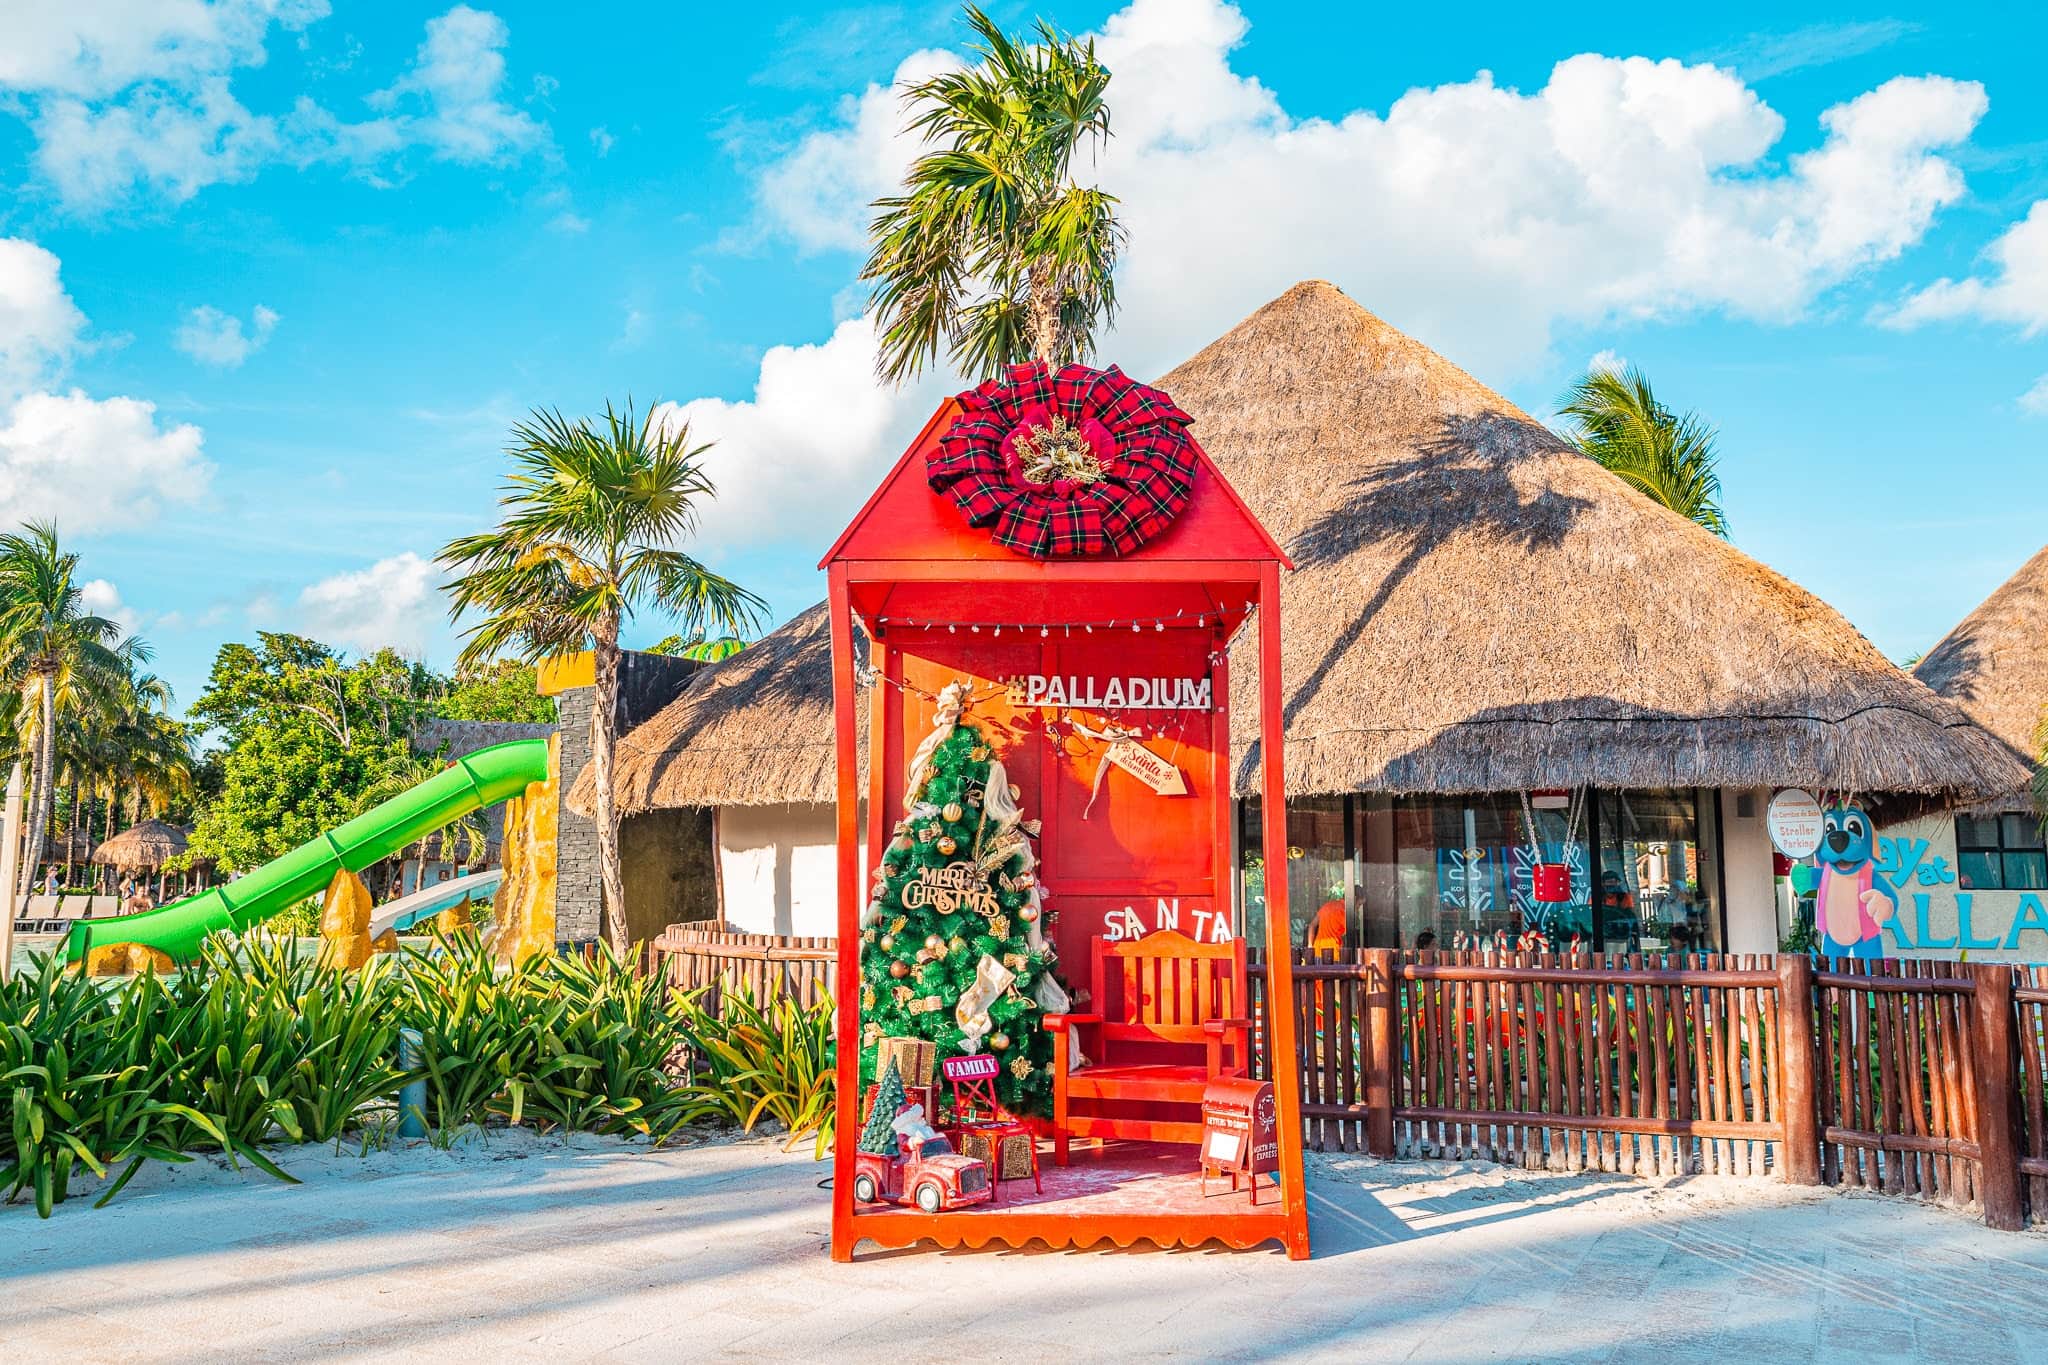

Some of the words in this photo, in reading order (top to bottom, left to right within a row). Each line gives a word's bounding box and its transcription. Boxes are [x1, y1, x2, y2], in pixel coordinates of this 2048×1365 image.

[1006, 675, 1211, 708] #PALLADIUM
[1128, 748, 1161, 777] Santa
[1780, 824, 1815, 836] Stroller
[1783, 839, 1815, 850] Parking
[917, 861, 978, 891] MER
[1917, 856, 1955, 886] at
[902, 880, 1000, 917] CHRISTMAS
[946, 1057, 997, 1077] FAMILY
[1256, 1150, 1277, 1160] EXPRESS
